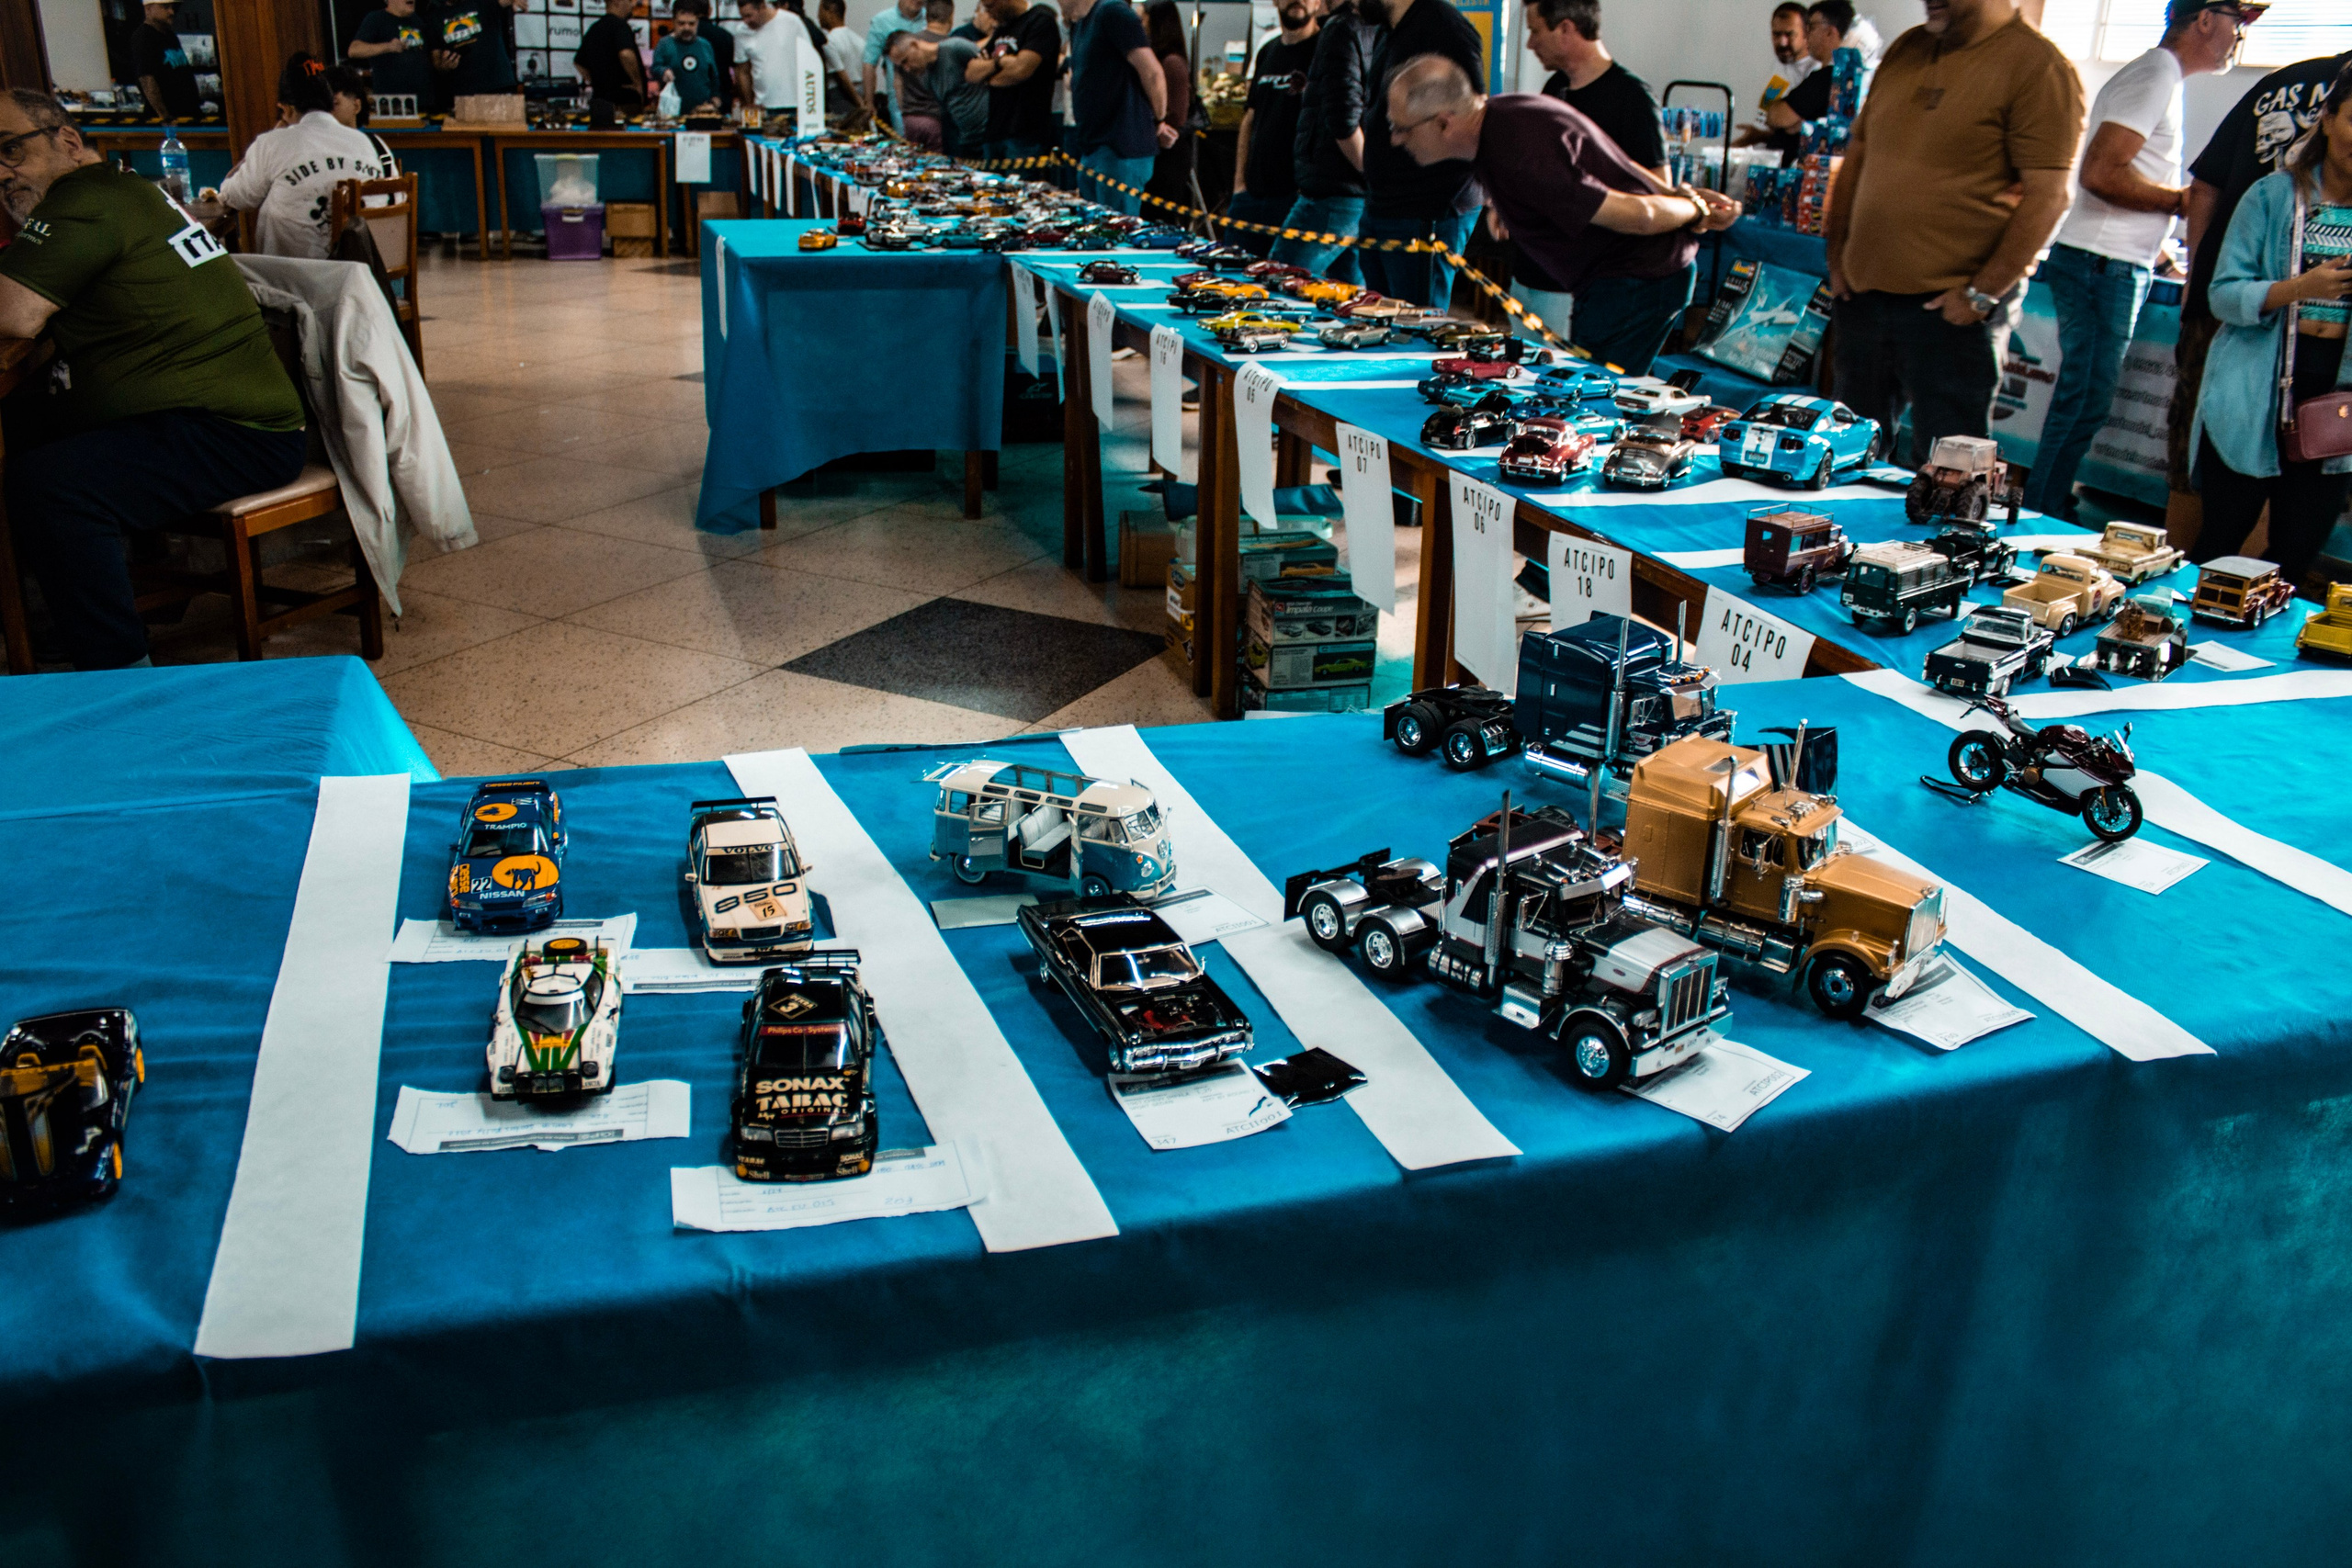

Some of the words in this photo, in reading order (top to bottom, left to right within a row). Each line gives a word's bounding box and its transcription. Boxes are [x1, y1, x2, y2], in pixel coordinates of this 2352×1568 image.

[805, 70, 817, 115] AUTOS
[2253, 83, 2305, 117] GAS
[285, 161, 320, 186] SIDE
[326, 157, 345, 170] BY
[1244, 368, 1273, 392] ATCIPO
[1349, 434, 1381, 459] ATCIPO
[1357, 456, 1366, 473] 07
[1464, 486, 1500, 521] ATCIPO
[1475, 512, 1485, 534] 06
[1565, 547, 1614, 580] ATCIPO
[1577, 576, 1592, 597] 18
[1721, 608, 1786, 660] ATCIPO
[1731, 643, 1751, 672] 04
[723, 845, 775, 854] VOLVO
[471, 876, 492, 893] 22
[479, 890, 526, 899] NISSAN
[714, 882, 797, 914] 850
[763, 905, 775, 918] 15
[779, 1001, 800, 1013] 3
[767, 1027, 793, 1035] Philips
[755, 1077, 846, 1094] SONAX
[755, 1093, 849, 1112] TABAC
[1155, 1137, 1177, 1146] 347
[749, 1170, 770, 1180] Shell
[836, 1166, 859, 1177] Shell
